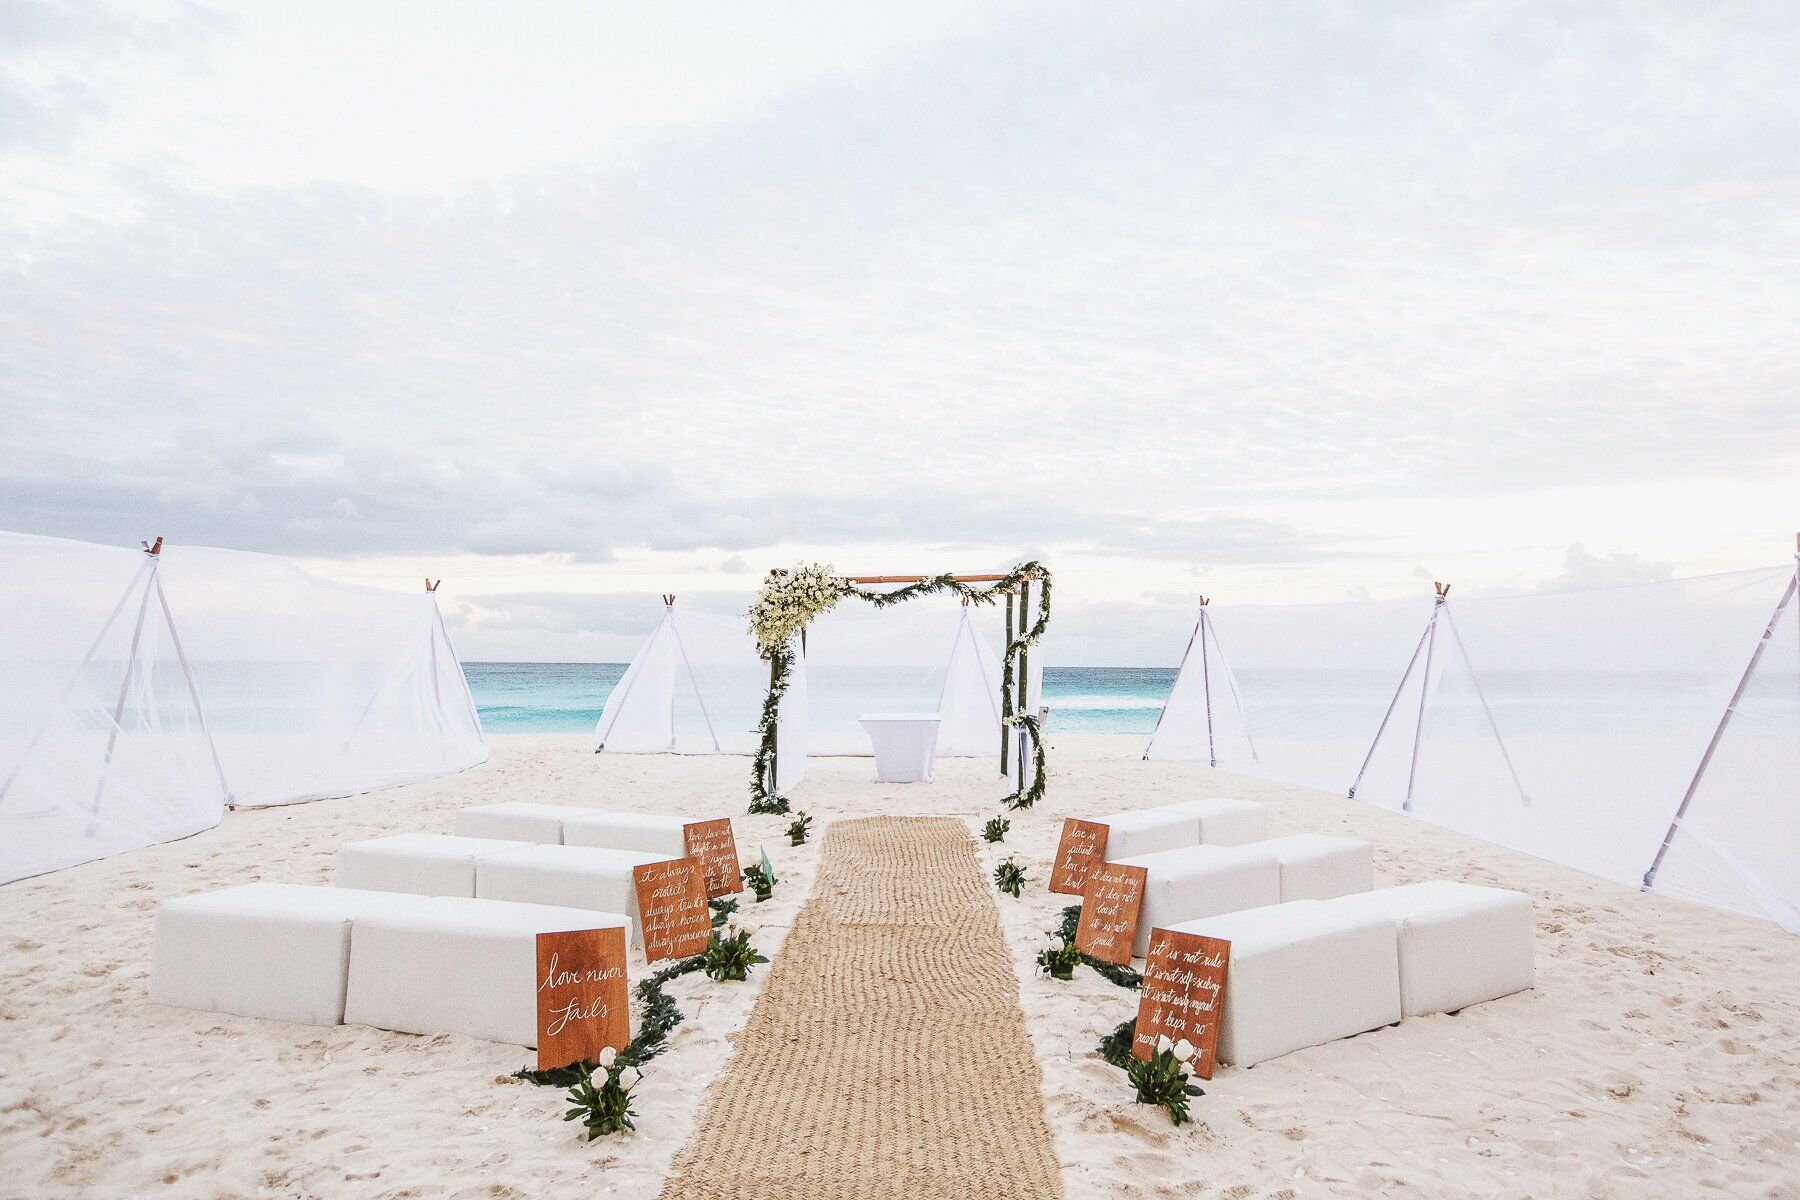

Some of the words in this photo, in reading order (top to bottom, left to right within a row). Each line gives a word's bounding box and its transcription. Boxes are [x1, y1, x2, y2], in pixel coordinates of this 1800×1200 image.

[1067, 823, 1087, 838] love
[1087, 830, 1097, 840] is
[1067, 841, 1097, 858] patient
[638, 865, 659, 883] it
[660, 861, 695, 883] always
[721, 864, 733, 874] the
[1061, 855, 1078, 871] love
[1079, 863, 1091, 873] is
[706, 875, 733, 891] truth
[1061, 873, 1088, 889] kind
[1090, 868, 1102, 881] it
[1100, 870, 1113, 883] does
[1112, 872, 1127, 884] not
[649, 881, 686, 907] protects
[1094, 885, 1106, 898] it
[1105, 886, 1120, 900] does
[1120, 890, 1137, 903] not
[645, 901, 676, 920] always
[676, 893, 704, 912] trusts
[1095, 901, 1123, 916] boast
[646, 915, 678, 934] always
[677, 913, 705, 930] hopes
[1089, 916, 1102, 929] it
[1102, 921, 1113, 932] is
[1112, 919, 1128, 933] not
[1085, 936, 1116, 955] proud
[1150, 940, 1169, 956] it
[1166, 947, 1180, 960] is
[1183, 948, 1205, 964] not
[1201, 952, 1225, 968] rude
[538, 952, 582, 992] love
[586, 966, 625, 982] never
[1144, 962, 1156, 977] it
[1154, 968, 1167, 980] is
[1164, 967, 1182, 981] not
[1140, 982, 1155, 999] it
[1151, 988, 1165, 1001] is
[1160, 988, 1177, 1003] not
[1173, 992, 1190, 1013] easily
[1189, 997, 1219, 1016] angered
[547, 996, 614, 1036] fails
[1151, 1006, 1165, 1025] it
[1164, 1010, 1188, 1035] keeps
[1193, 1022, 1213, 1035] no
[1136, 1032, 1160, 1047] record
